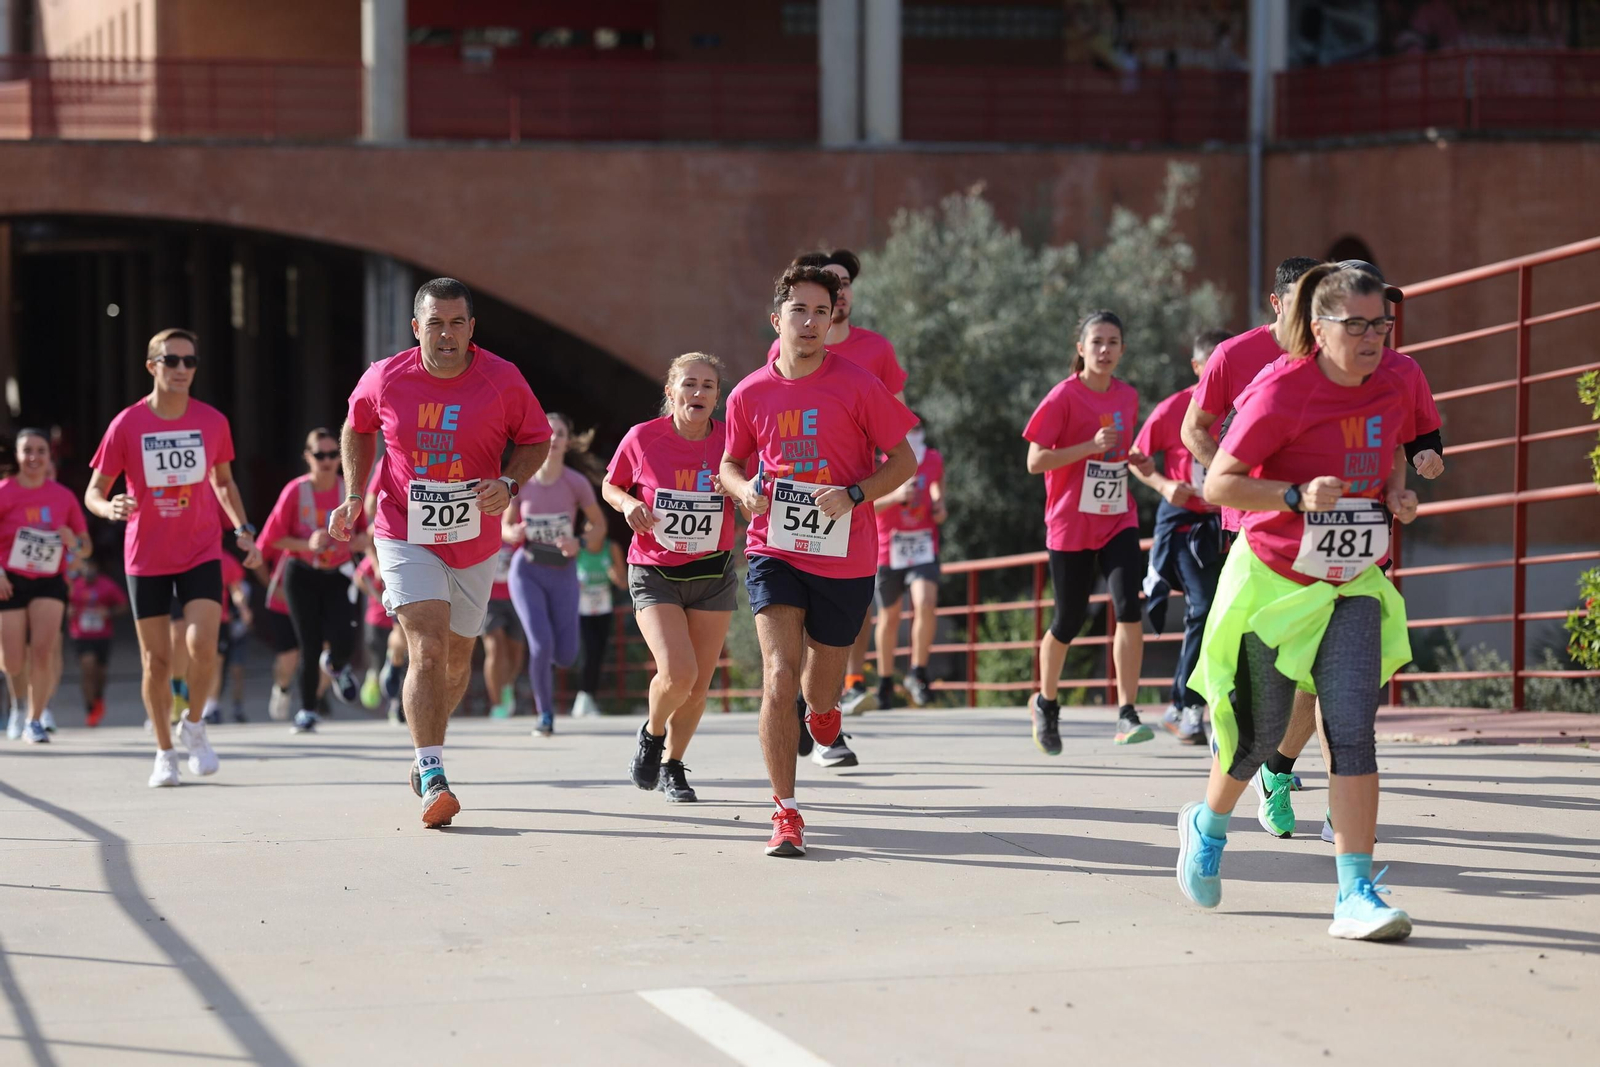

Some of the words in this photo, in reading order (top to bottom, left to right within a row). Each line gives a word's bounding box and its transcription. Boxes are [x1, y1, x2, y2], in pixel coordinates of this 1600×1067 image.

[417, 403, 461, 431] WE
[777, 409, 818, 438] WE
[417, 431, 454, 452] RUN
[1340, 415, 1382, 449] WE
[145, 440, 173, 450] UMA
[781, 440, 818, 460] RUN
[155, 449, 196, 471] 108
[411, 451, 465, 479] UMA
[1344, 452, 1379, 477] RUN
[675, 469, 713, 492] WE
[1088, 468, 1115, 479] UMA
[411, 491, 445, 502] UMA
[777, 490, 812, 504] UMA
[1093, 480, 1123, 500] 671
[421, 502, 470, 527] 202
[657, 498, 689, 511] UMA
[664, 512, 712, 536] 204
[783, 505, 837, 536] 547
[1308, 511, 1349, 524] UMA
[21, 544, 56, 562] 452
[795, 541, 809, 549] WE
[1316, 528, 1374, 558] 481
